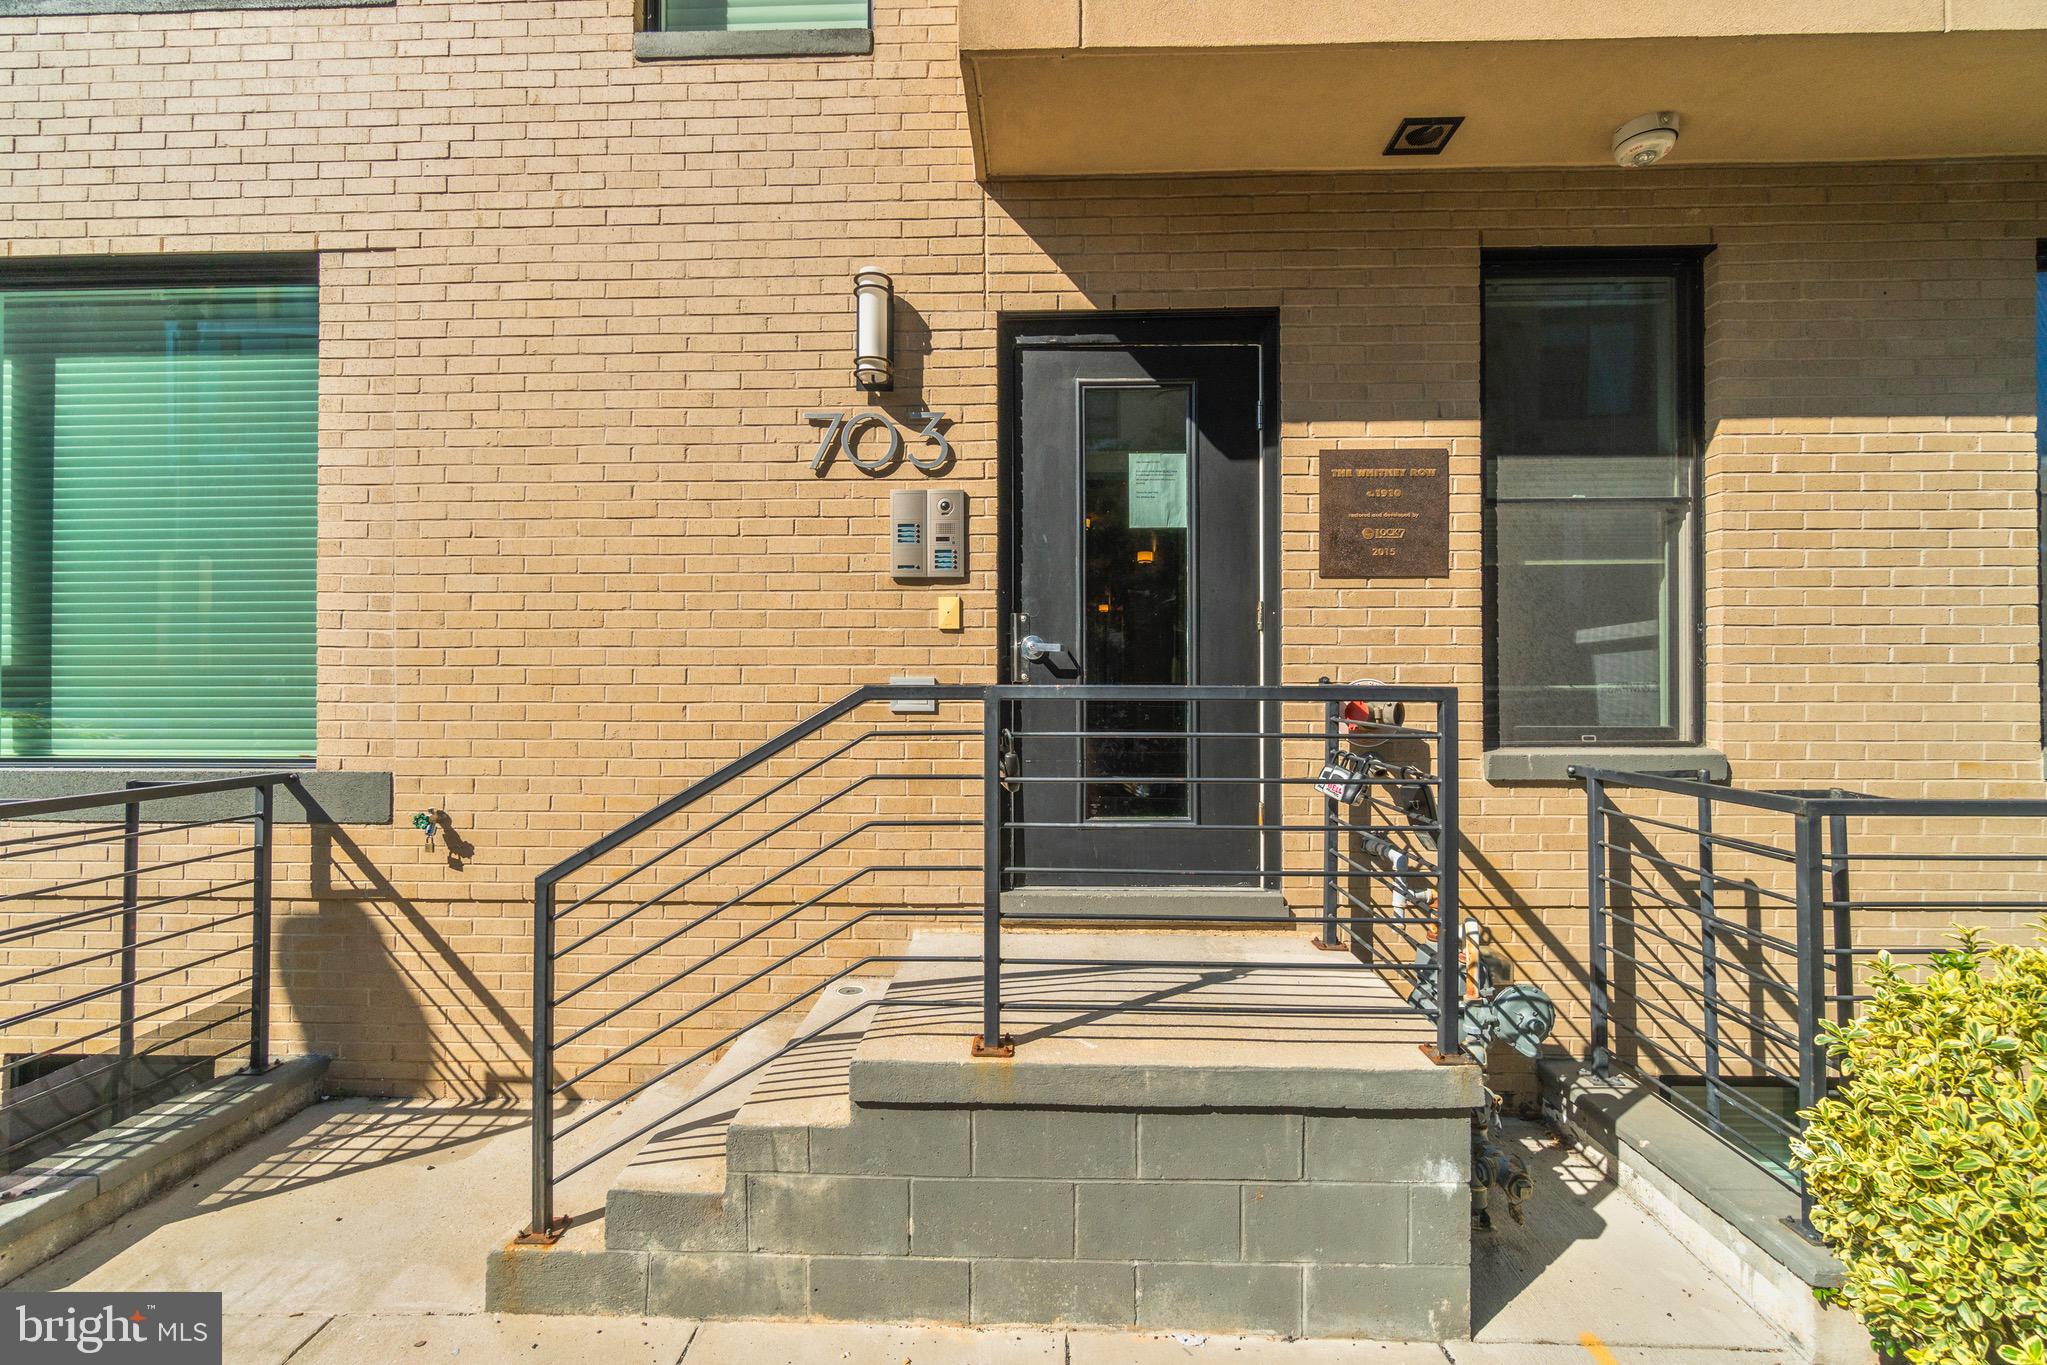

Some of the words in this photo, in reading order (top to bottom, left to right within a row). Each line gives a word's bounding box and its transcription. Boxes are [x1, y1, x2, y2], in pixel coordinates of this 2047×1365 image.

[803, 412, 948, 470] 703
[1331, 468, 1352, 477] THE
[1356, 468, 1406, 477] WHITNEY
[1410, 468, 1436, 477] ROW
[1372, 547, 1397, 556] 2015
